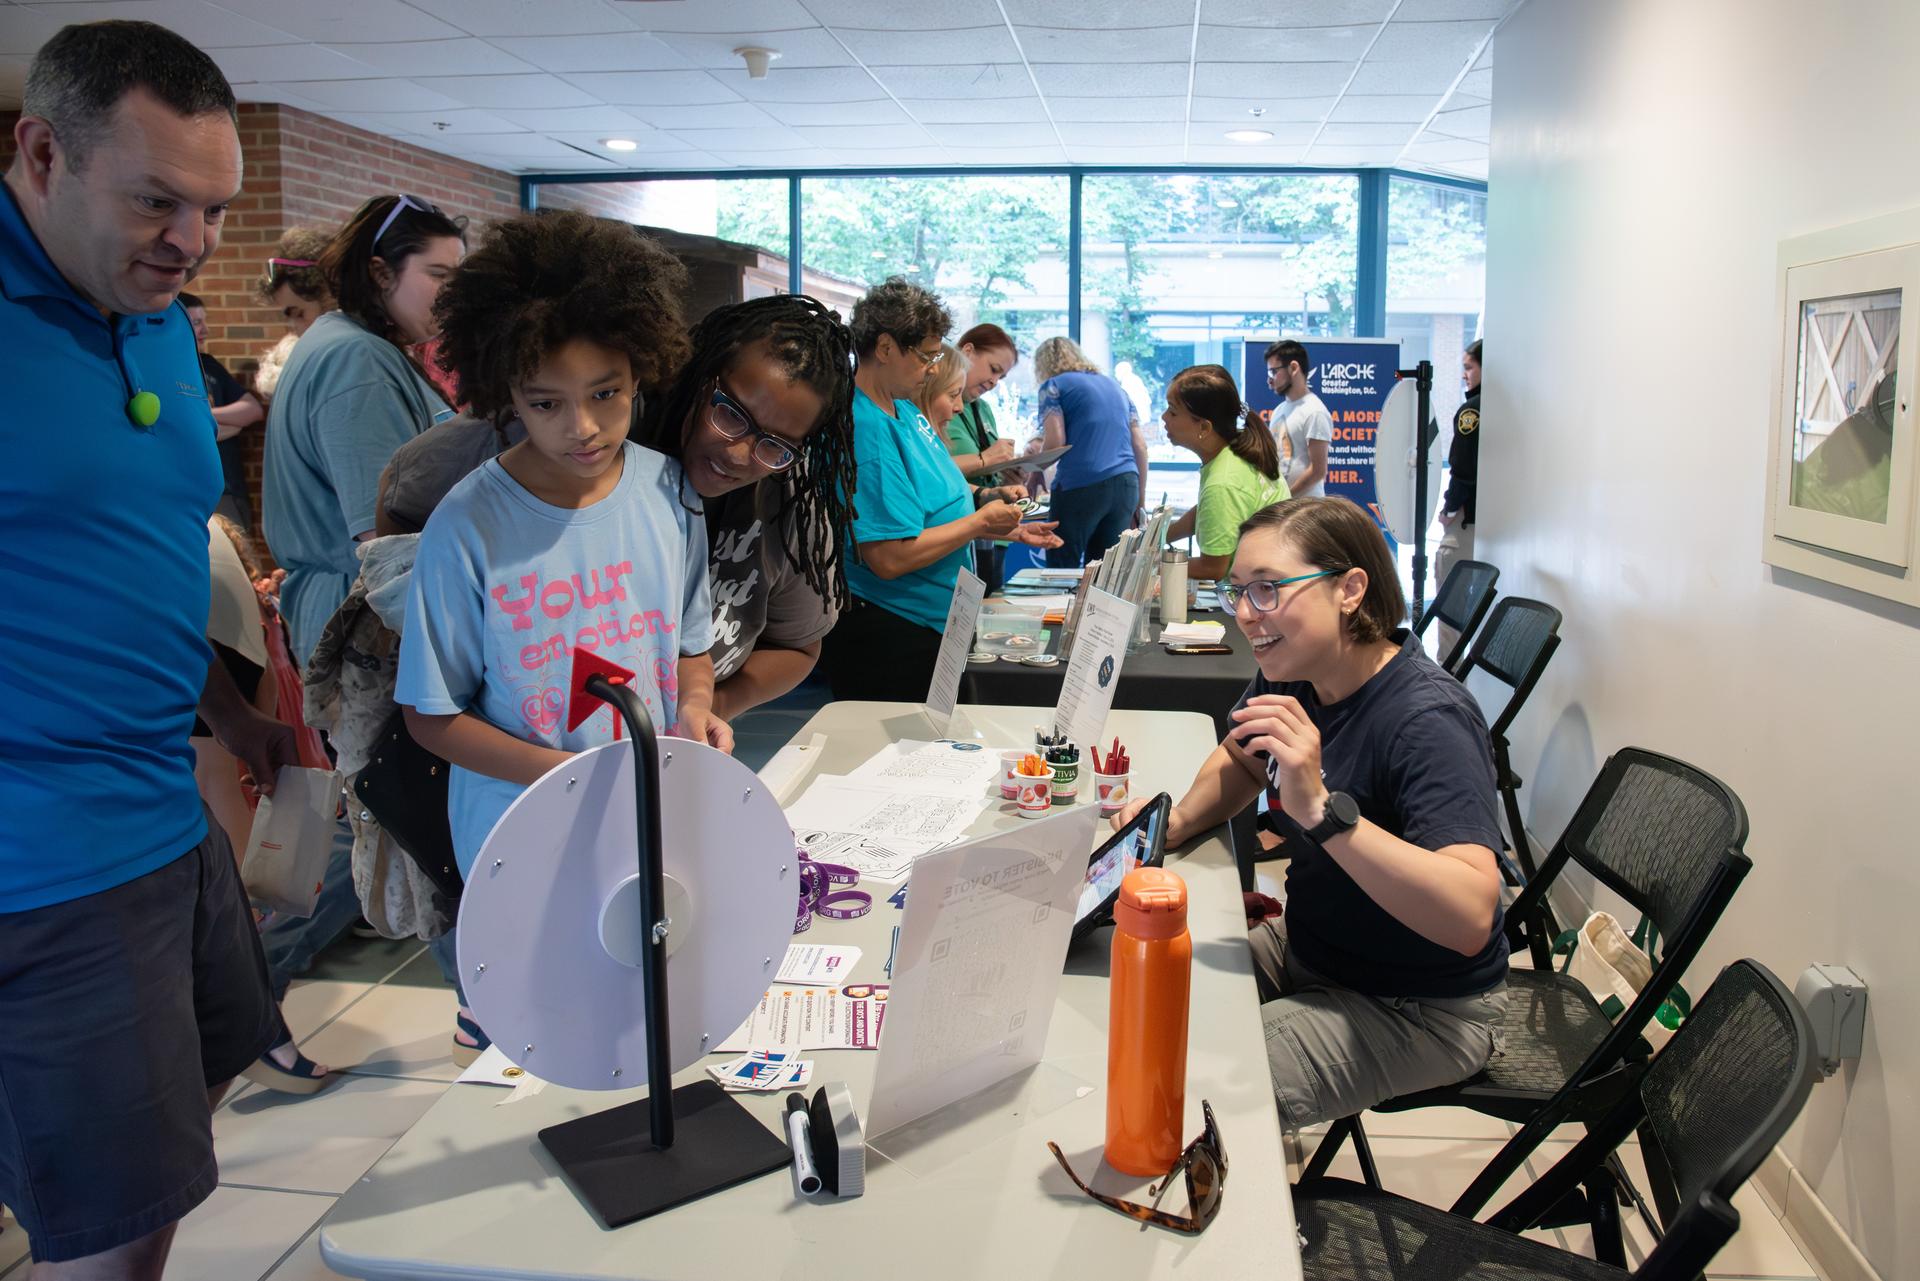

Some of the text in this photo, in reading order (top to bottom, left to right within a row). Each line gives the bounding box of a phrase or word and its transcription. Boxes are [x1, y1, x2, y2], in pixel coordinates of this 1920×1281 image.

[1321, 363, 1375, 380] L'ARCHE
[1321, 379, 1349, 387] Greater
[1321, 386, 1377, 396] Washington, D.C.
[1343, 410, 1383, 423] MORE
[1332, 427, 1377, 441] OCIET
[1335, 444, 1350, 454] and
[1346, 456, 1368, 465] share
[491, 560, 633, 632] Your
[1055, 769, 1077, 778] TIVIA
